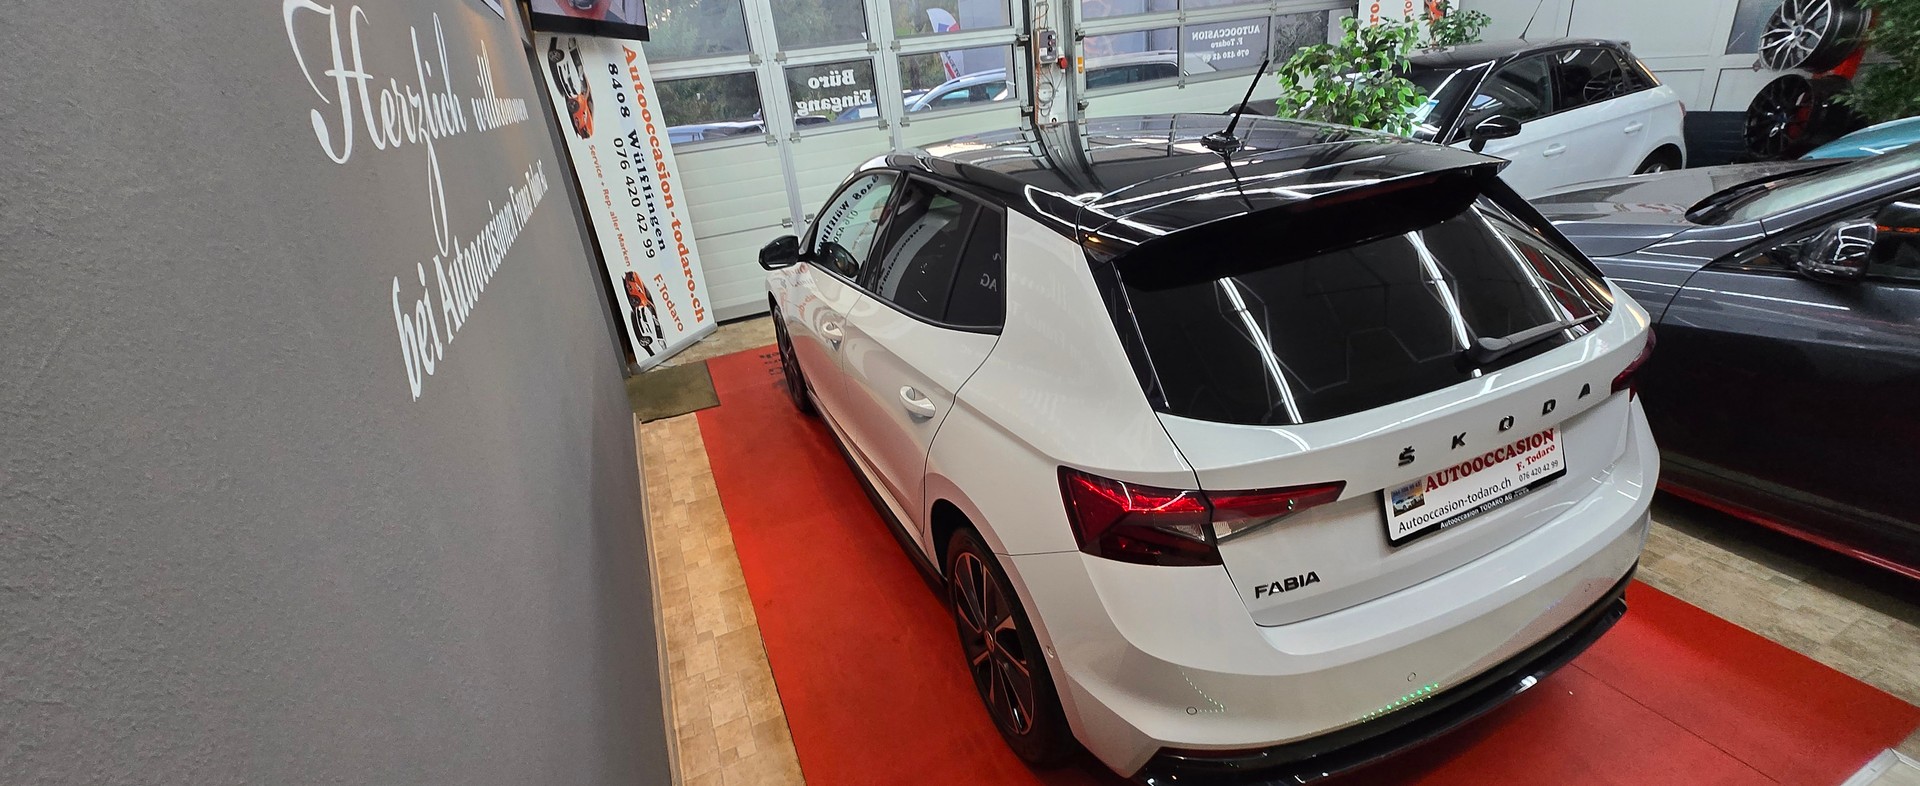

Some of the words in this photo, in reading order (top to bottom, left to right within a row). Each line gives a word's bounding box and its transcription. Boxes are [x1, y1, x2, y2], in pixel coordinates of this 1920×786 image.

[283, 0, 467, 257] Herzlich
[471, 40, 529, 132] willkommen
[608, 62, 631, 119] 8408
[628, 128, 666, 251] Wülflingen
[589, 144, 603, 179] Service
[603, 188, 612, 209] Rep.
[609, 211, 620, 231] aller
[617, 233, 631, 267] Marken
[613, 137, 631, 170] 076
[625, 175, 641, 208] 420
[636, 212, 648, 234] 42
[643, 238, 656, 259] 99
[622, 44, 705, 323] Autooccasion-todaro.ch
[393, 262, 443, 402] bei
[433, 200, 518, 344] Autooccasionen
[653, 273, 684, 332] F.Todaro
[1398, 383, 1591, 467] ŠKODA
[1425, 428, 1555, 492] AUTOOCCASION
[1516, 462, 1525, 471] F.
[1525, 444, 1555, 465] Todaro
[1398, 477, 1511, 533] Autooccasion-todaro.ch
[1518, 471, 1530, 482] 076
[1531, 467, 1541, 476] 420
[1543, 463, 1549, 471] 42
[1551, 460, 1558, 468] 99
[1440, 509, 1479, 529] Autooccasion
[1479, 498, 1504, 513] TODARO
[1504, 493, 1513, 503] AG
[1254, 571, 1321, 599] FABIA
